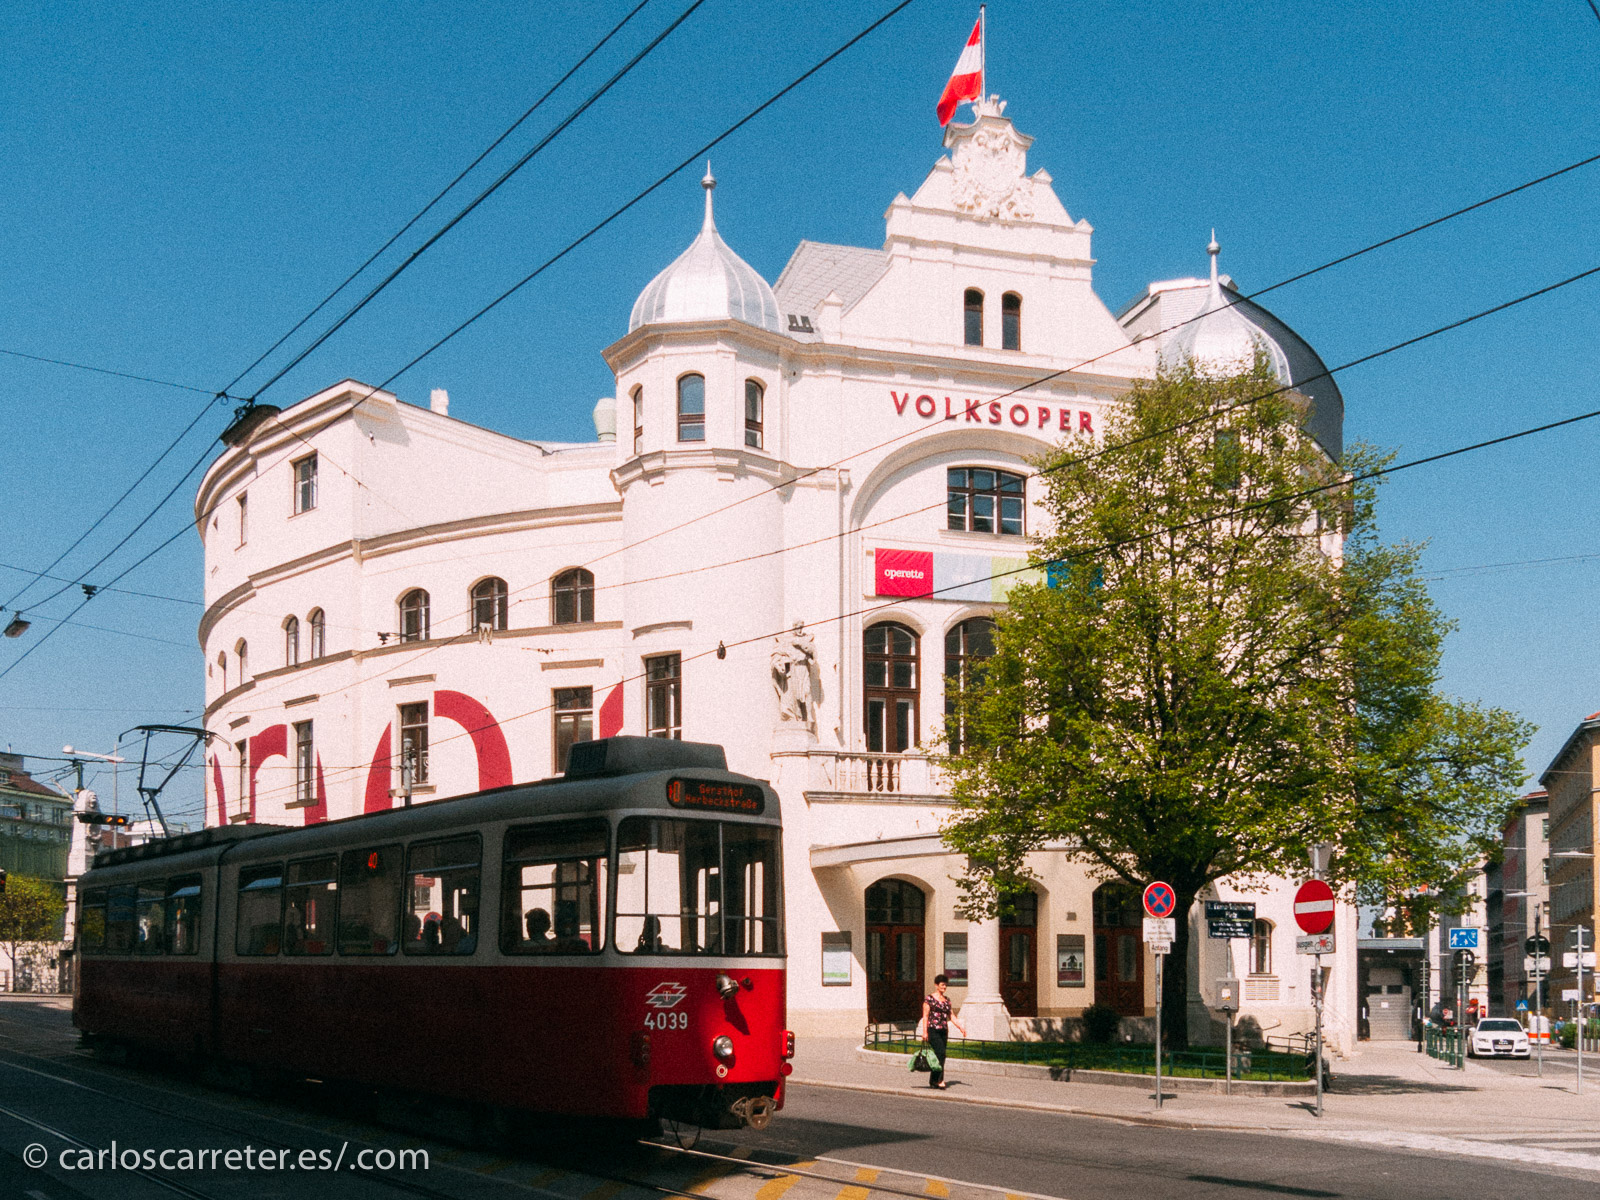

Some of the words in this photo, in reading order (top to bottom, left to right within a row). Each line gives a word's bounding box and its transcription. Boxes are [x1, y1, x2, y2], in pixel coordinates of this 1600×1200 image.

[890, 391, 1095, 433] VOLKSOPER
[884, 568, 924, 580] operette
[699, 784, 744, 797] Gersthof
[644, 1012, 688, 1030] 4039
